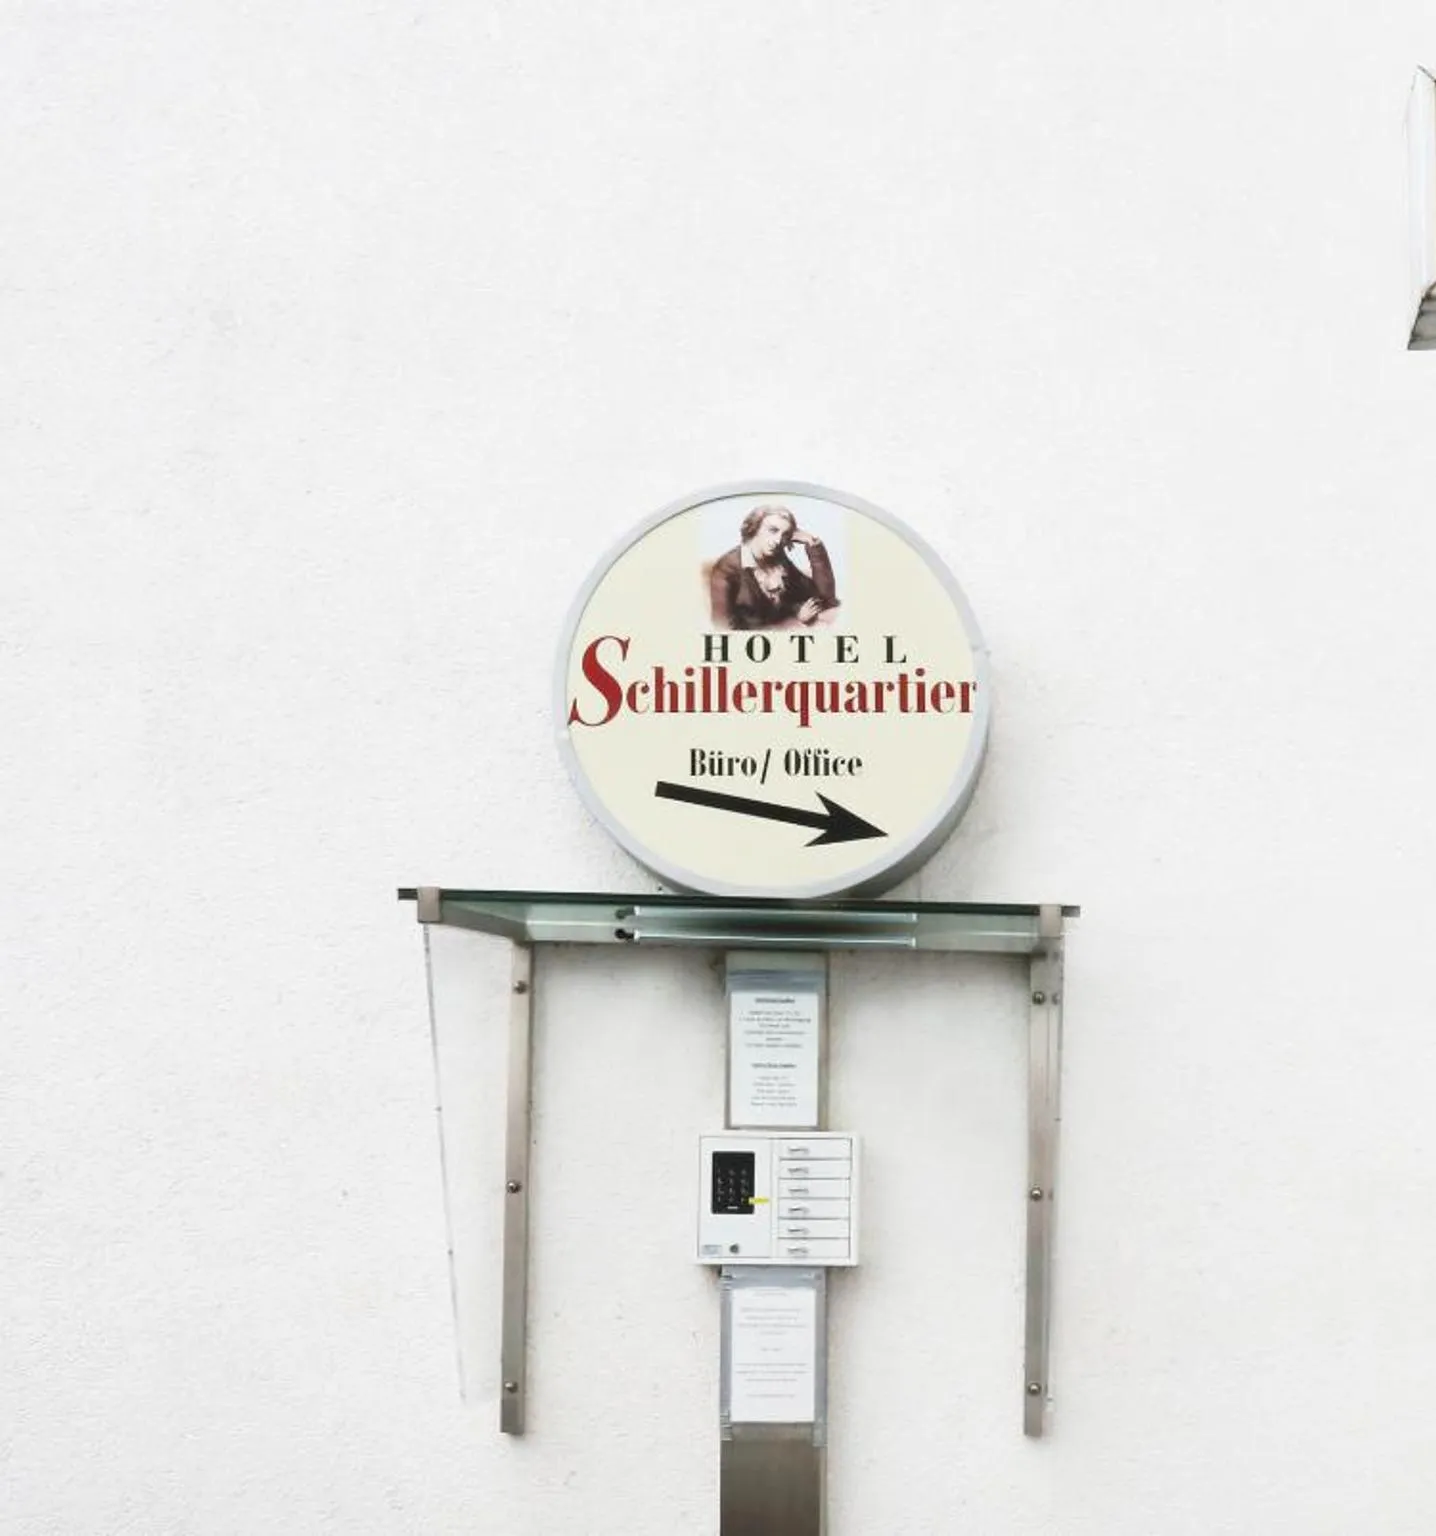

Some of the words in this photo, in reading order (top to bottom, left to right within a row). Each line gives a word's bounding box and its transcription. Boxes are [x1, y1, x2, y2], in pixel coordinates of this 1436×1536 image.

[702, 634, 907, 664] HOTEL
[567, 634, 977, 728] Schillerquartier
[689, 747, 771, 784] Büro/
[784, 747, 863, 778] Office
